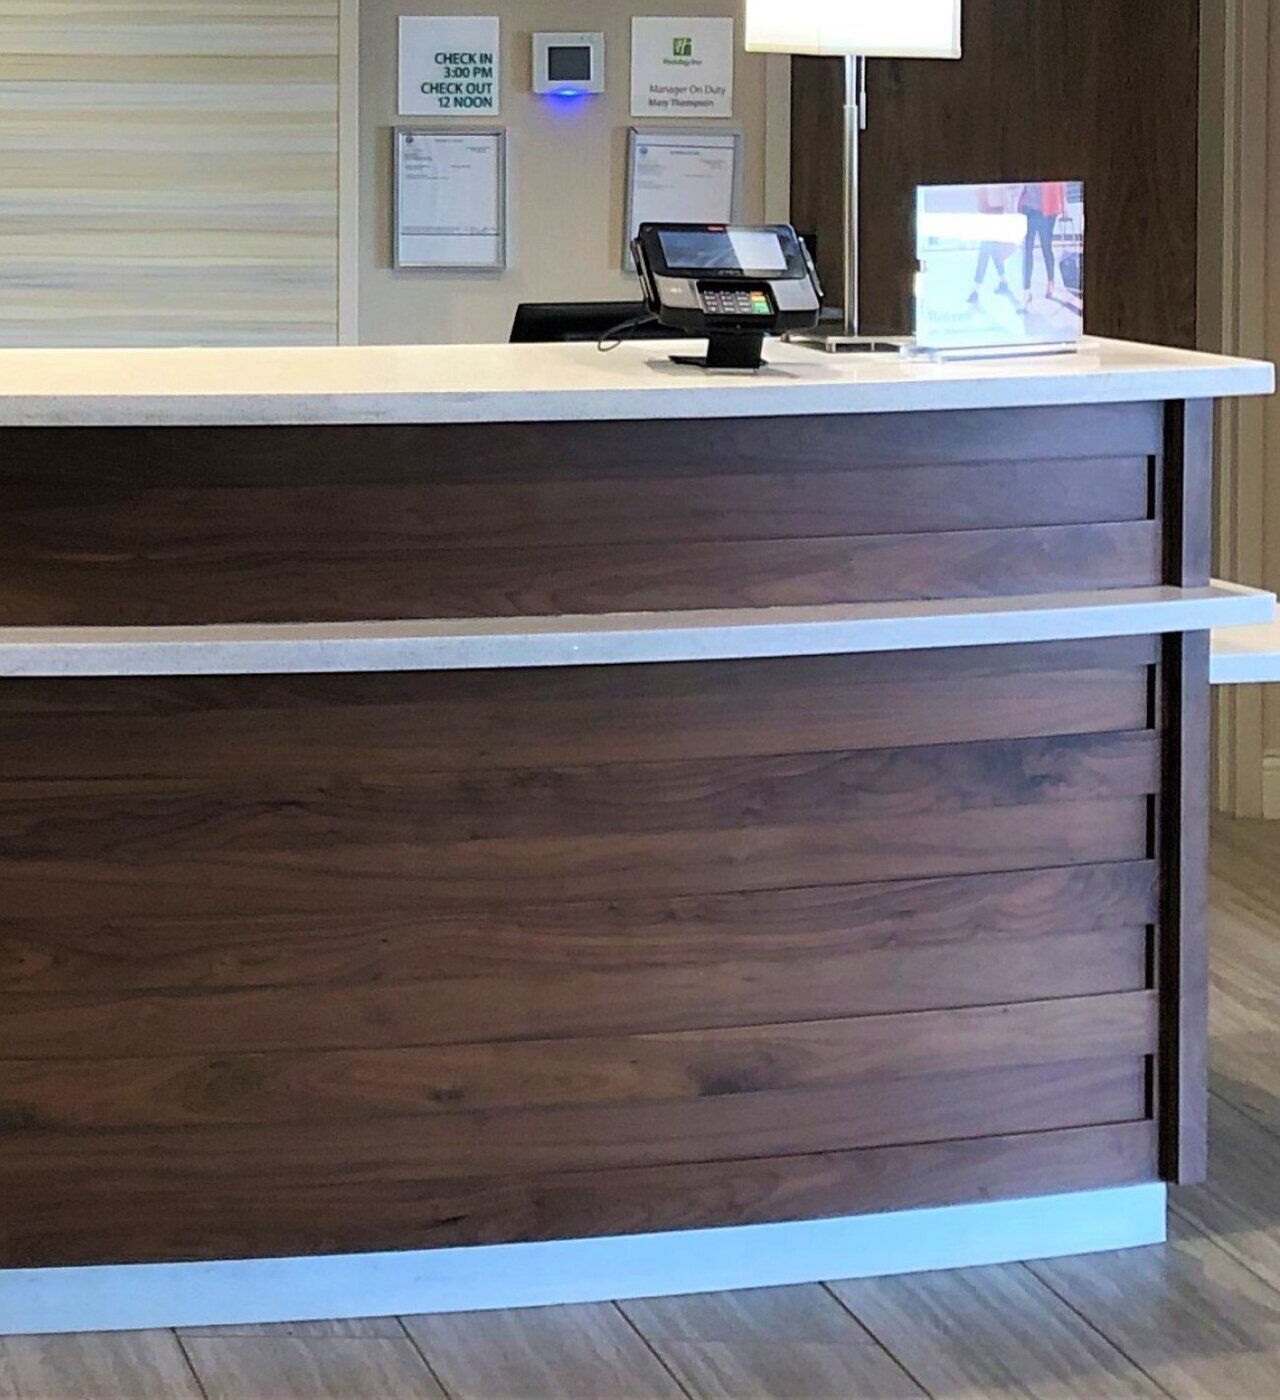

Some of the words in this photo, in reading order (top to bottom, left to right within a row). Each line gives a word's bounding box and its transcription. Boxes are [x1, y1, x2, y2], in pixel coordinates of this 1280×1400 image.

[434, 52, 477, 65] CHECK
[479, 52, 493, 65] IN
[444, 66, 471, 78] 3:00
[473, 66, 493, 78] PM
[421, 82, 463, 94] CHECK
[465, 82, 493, 94] OUT
[649, 85, 687, 96] Manager
[689, 85, 703, 94] On
[704, 85, 726, 96] Duty
[438, 96, 451, 108] 12
[453, 96, 493, 108] NOON
